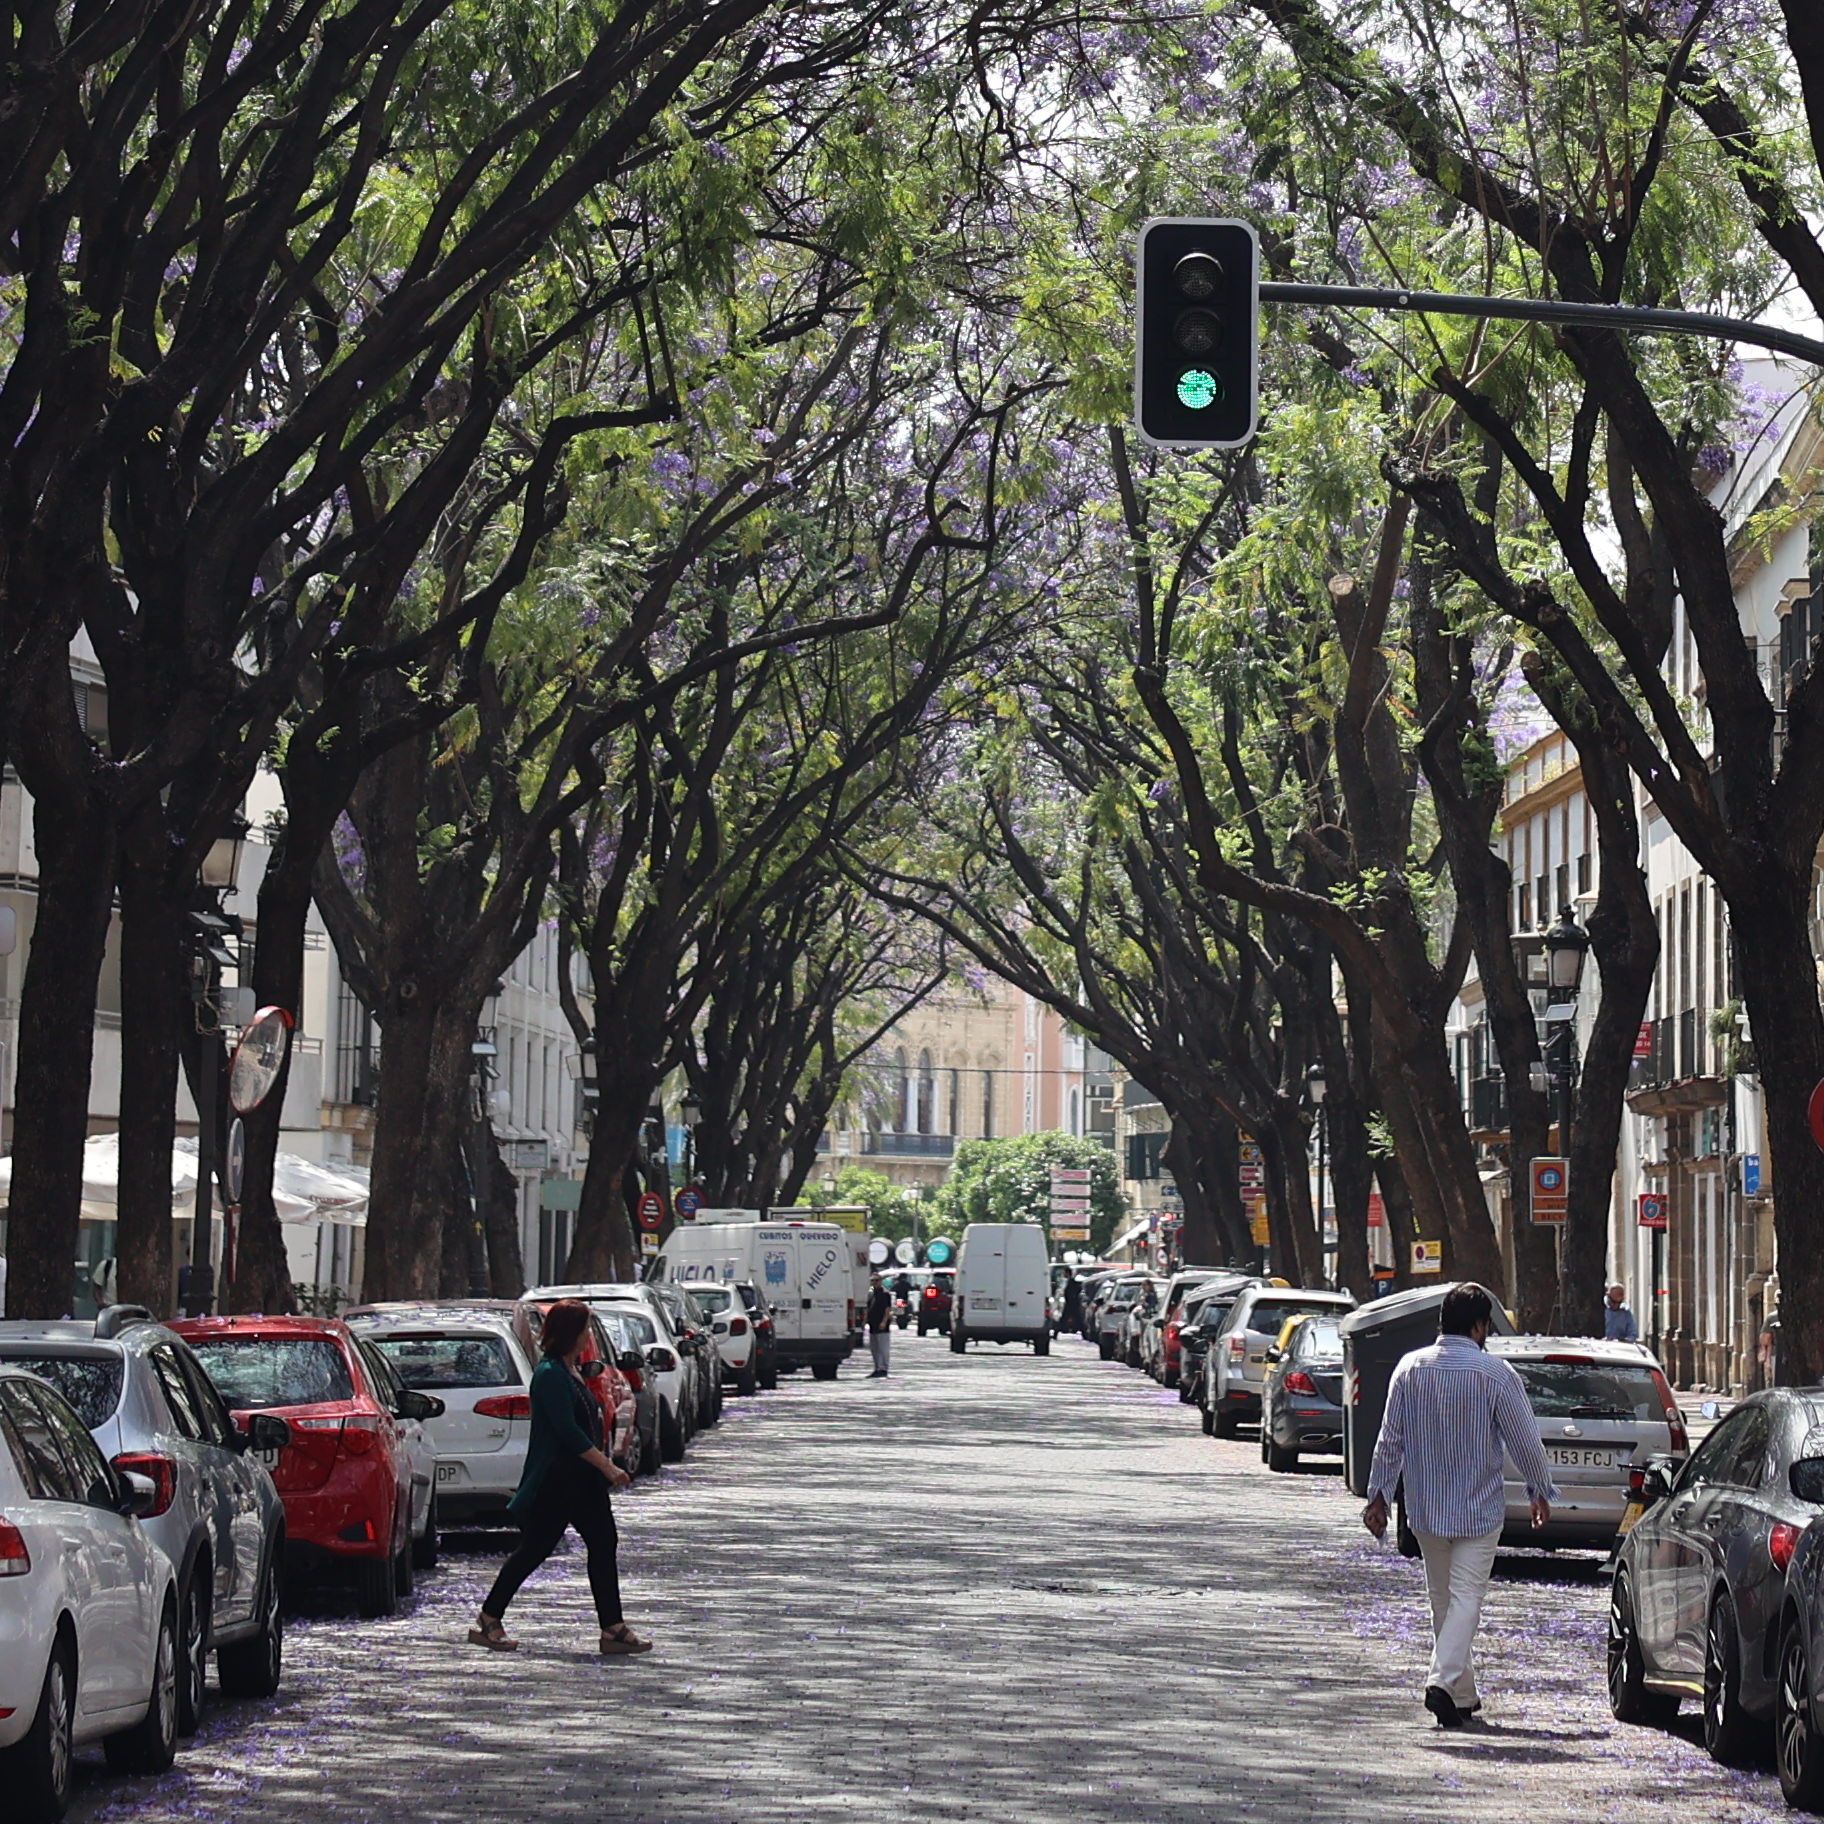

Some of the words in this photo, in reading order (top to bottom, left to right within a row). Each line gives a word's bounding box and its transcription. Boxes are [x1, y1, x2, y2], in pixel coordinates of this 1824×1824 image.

[759, 1232, 793, 1241] CUBITOS
[800, 1232, 839, 1241] QUEVEDO
[806, 1249, 838, 1291] HIELO
[1546, 1450, 1579, 1466] 153
[1583, 1451, 1613, 1467] FCJ
